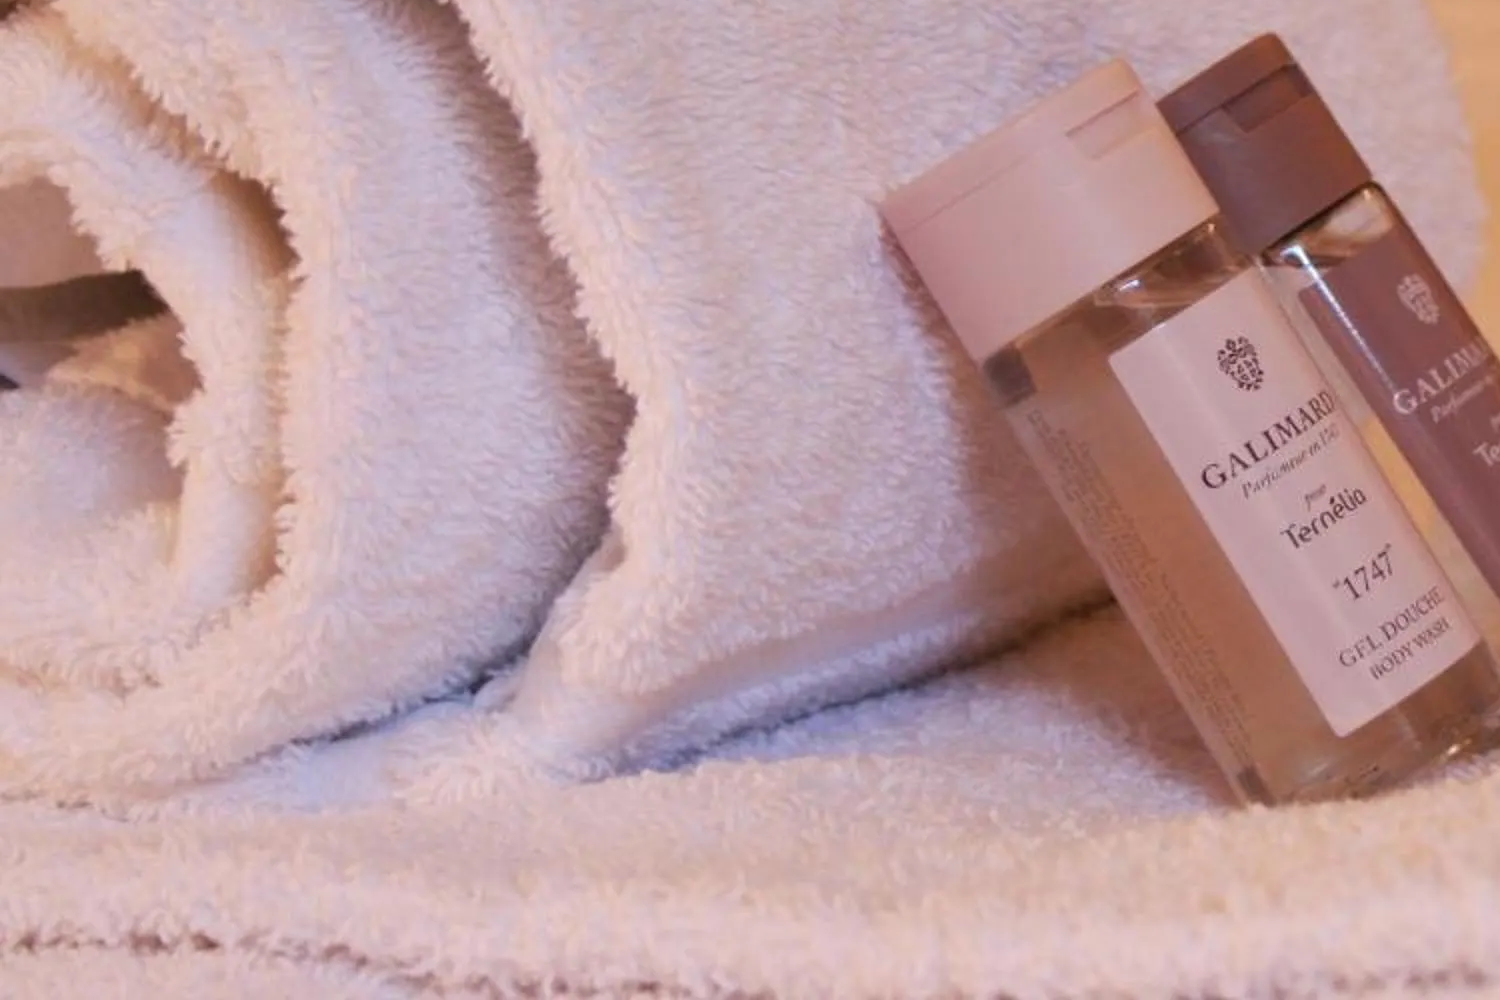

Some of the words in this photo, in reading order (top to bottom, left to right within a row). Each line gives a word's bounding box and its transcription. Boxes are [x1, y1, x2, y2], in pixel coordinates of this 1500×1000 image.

[1202, 390, 1336, 489] GALIMARD
[1280, 488, 1367, 549] Ternélia
[1332, 542, 1393, 600] "1747"
[1339, 634, 1384, 667] GEL
[1379, 586, 1446, 641] DOUCHE
[1370, 642, 1415, 680] BODY
[1412, 616, 1453, 648] WASH
